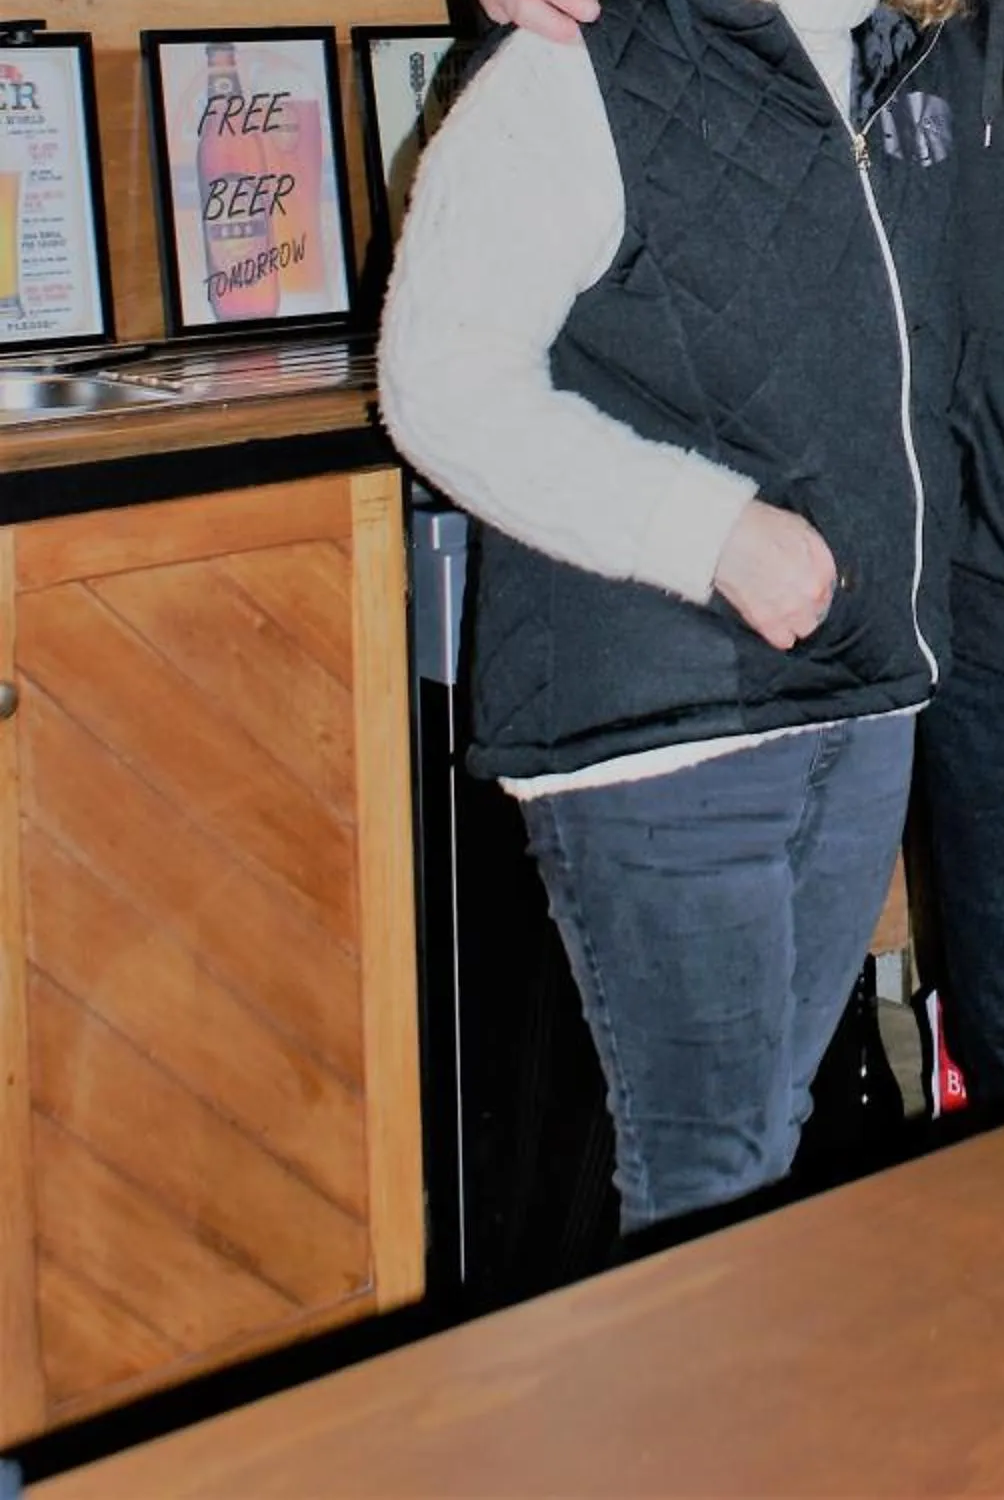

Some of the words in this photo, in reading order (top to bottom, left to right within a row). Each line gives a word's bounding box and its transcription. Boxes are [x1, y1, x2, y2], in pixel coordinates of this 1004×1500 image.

[197, 91, 291, 137] FREE
[202, 173, 296, 221] BEER
[203, 234, 308, 301] TOMORROW
